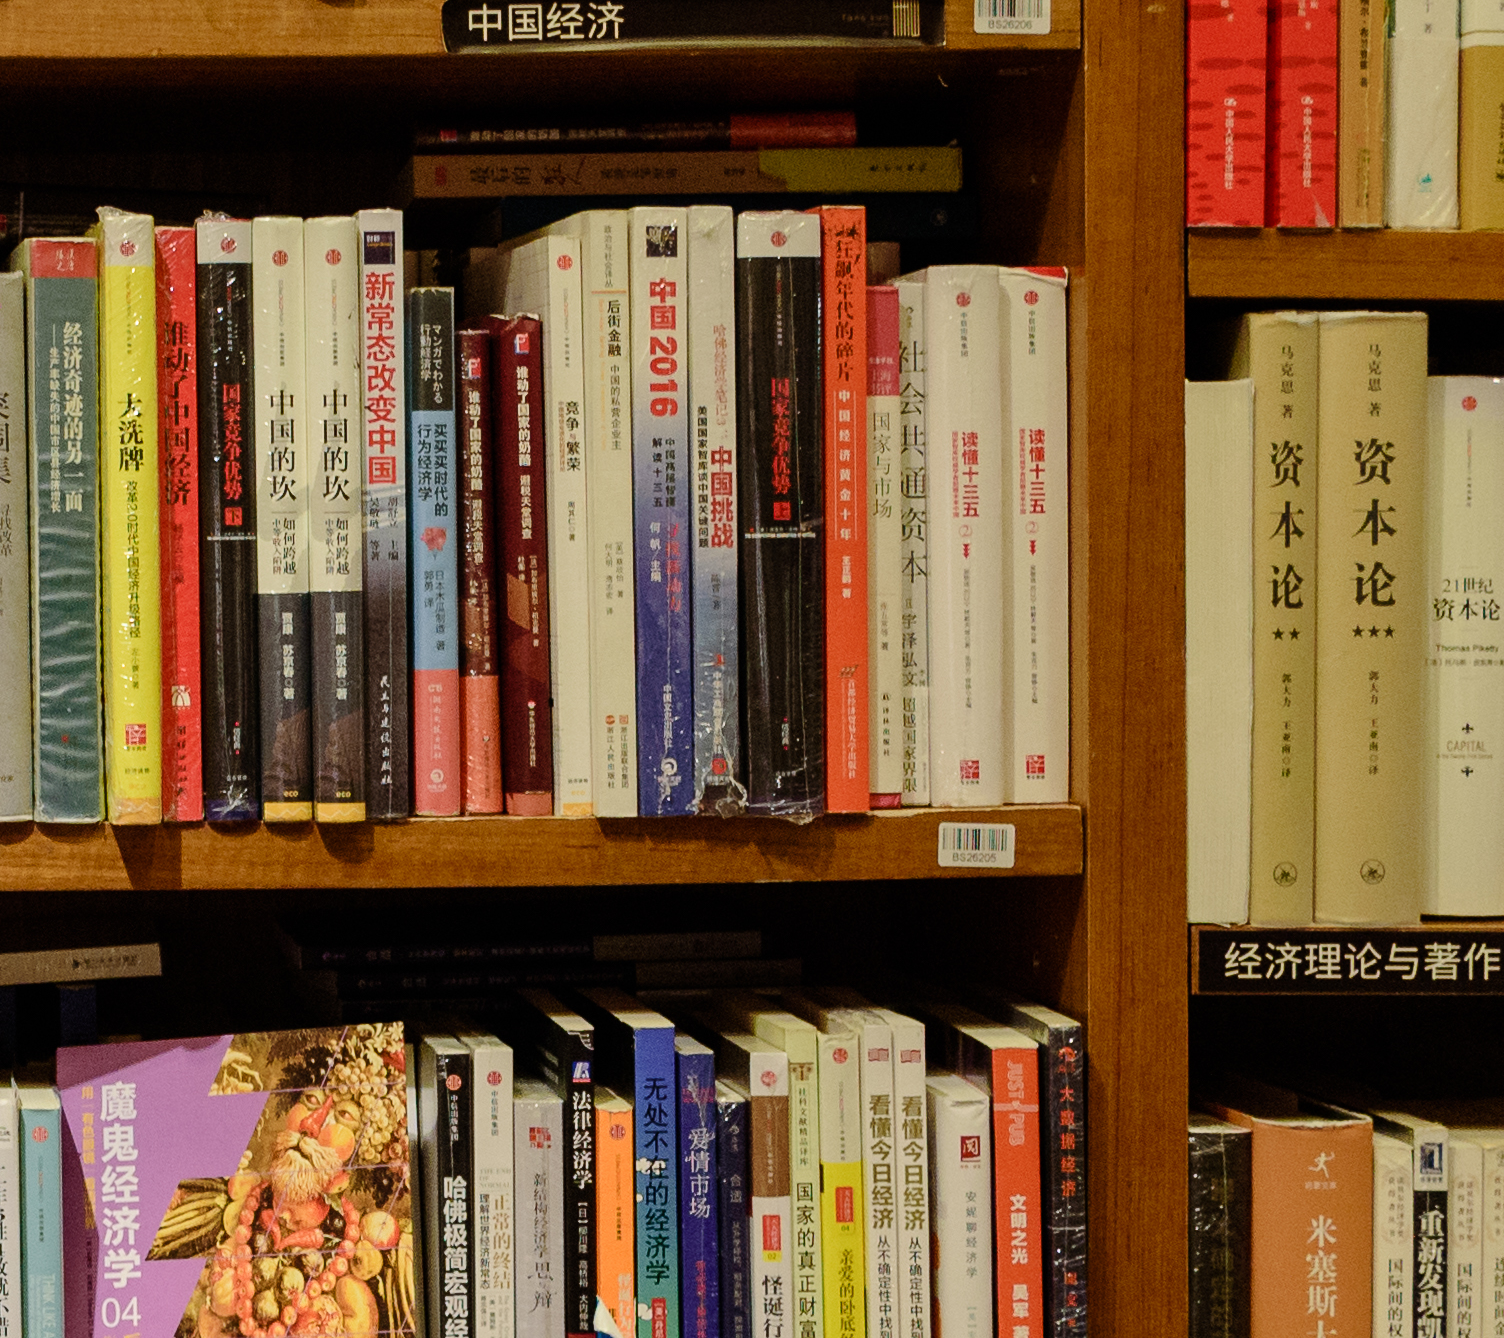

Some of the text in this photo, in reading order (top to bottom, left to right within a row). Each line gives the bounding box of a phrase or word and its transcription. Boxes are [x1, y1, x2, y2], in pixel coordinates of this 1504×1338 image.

[468, 1, 624, 42] 中国经济
[366, 272, 395, 485] 新常态改变中国
[650, 336, 678, 417] 2016
[322, 390, 350, 503] 中国的坎
[711, 446, 734, 549] 中国挑战
[962, 430, 978, 518] 读懂十三五
[1270, 440, 1304, 611] 资本论
[1353, 438, 1396, 608] 资本论
[1223, 942, 1501, 981] 经济理论与著作
[101, 1082, 140, 1291] 魔鬼经济学
[644, 1077, 670, 1287] 无处不在的经济学
[870, 1097, 892, 1231] 看懂今日经济
[102, 1297, 140, 1330] 04
